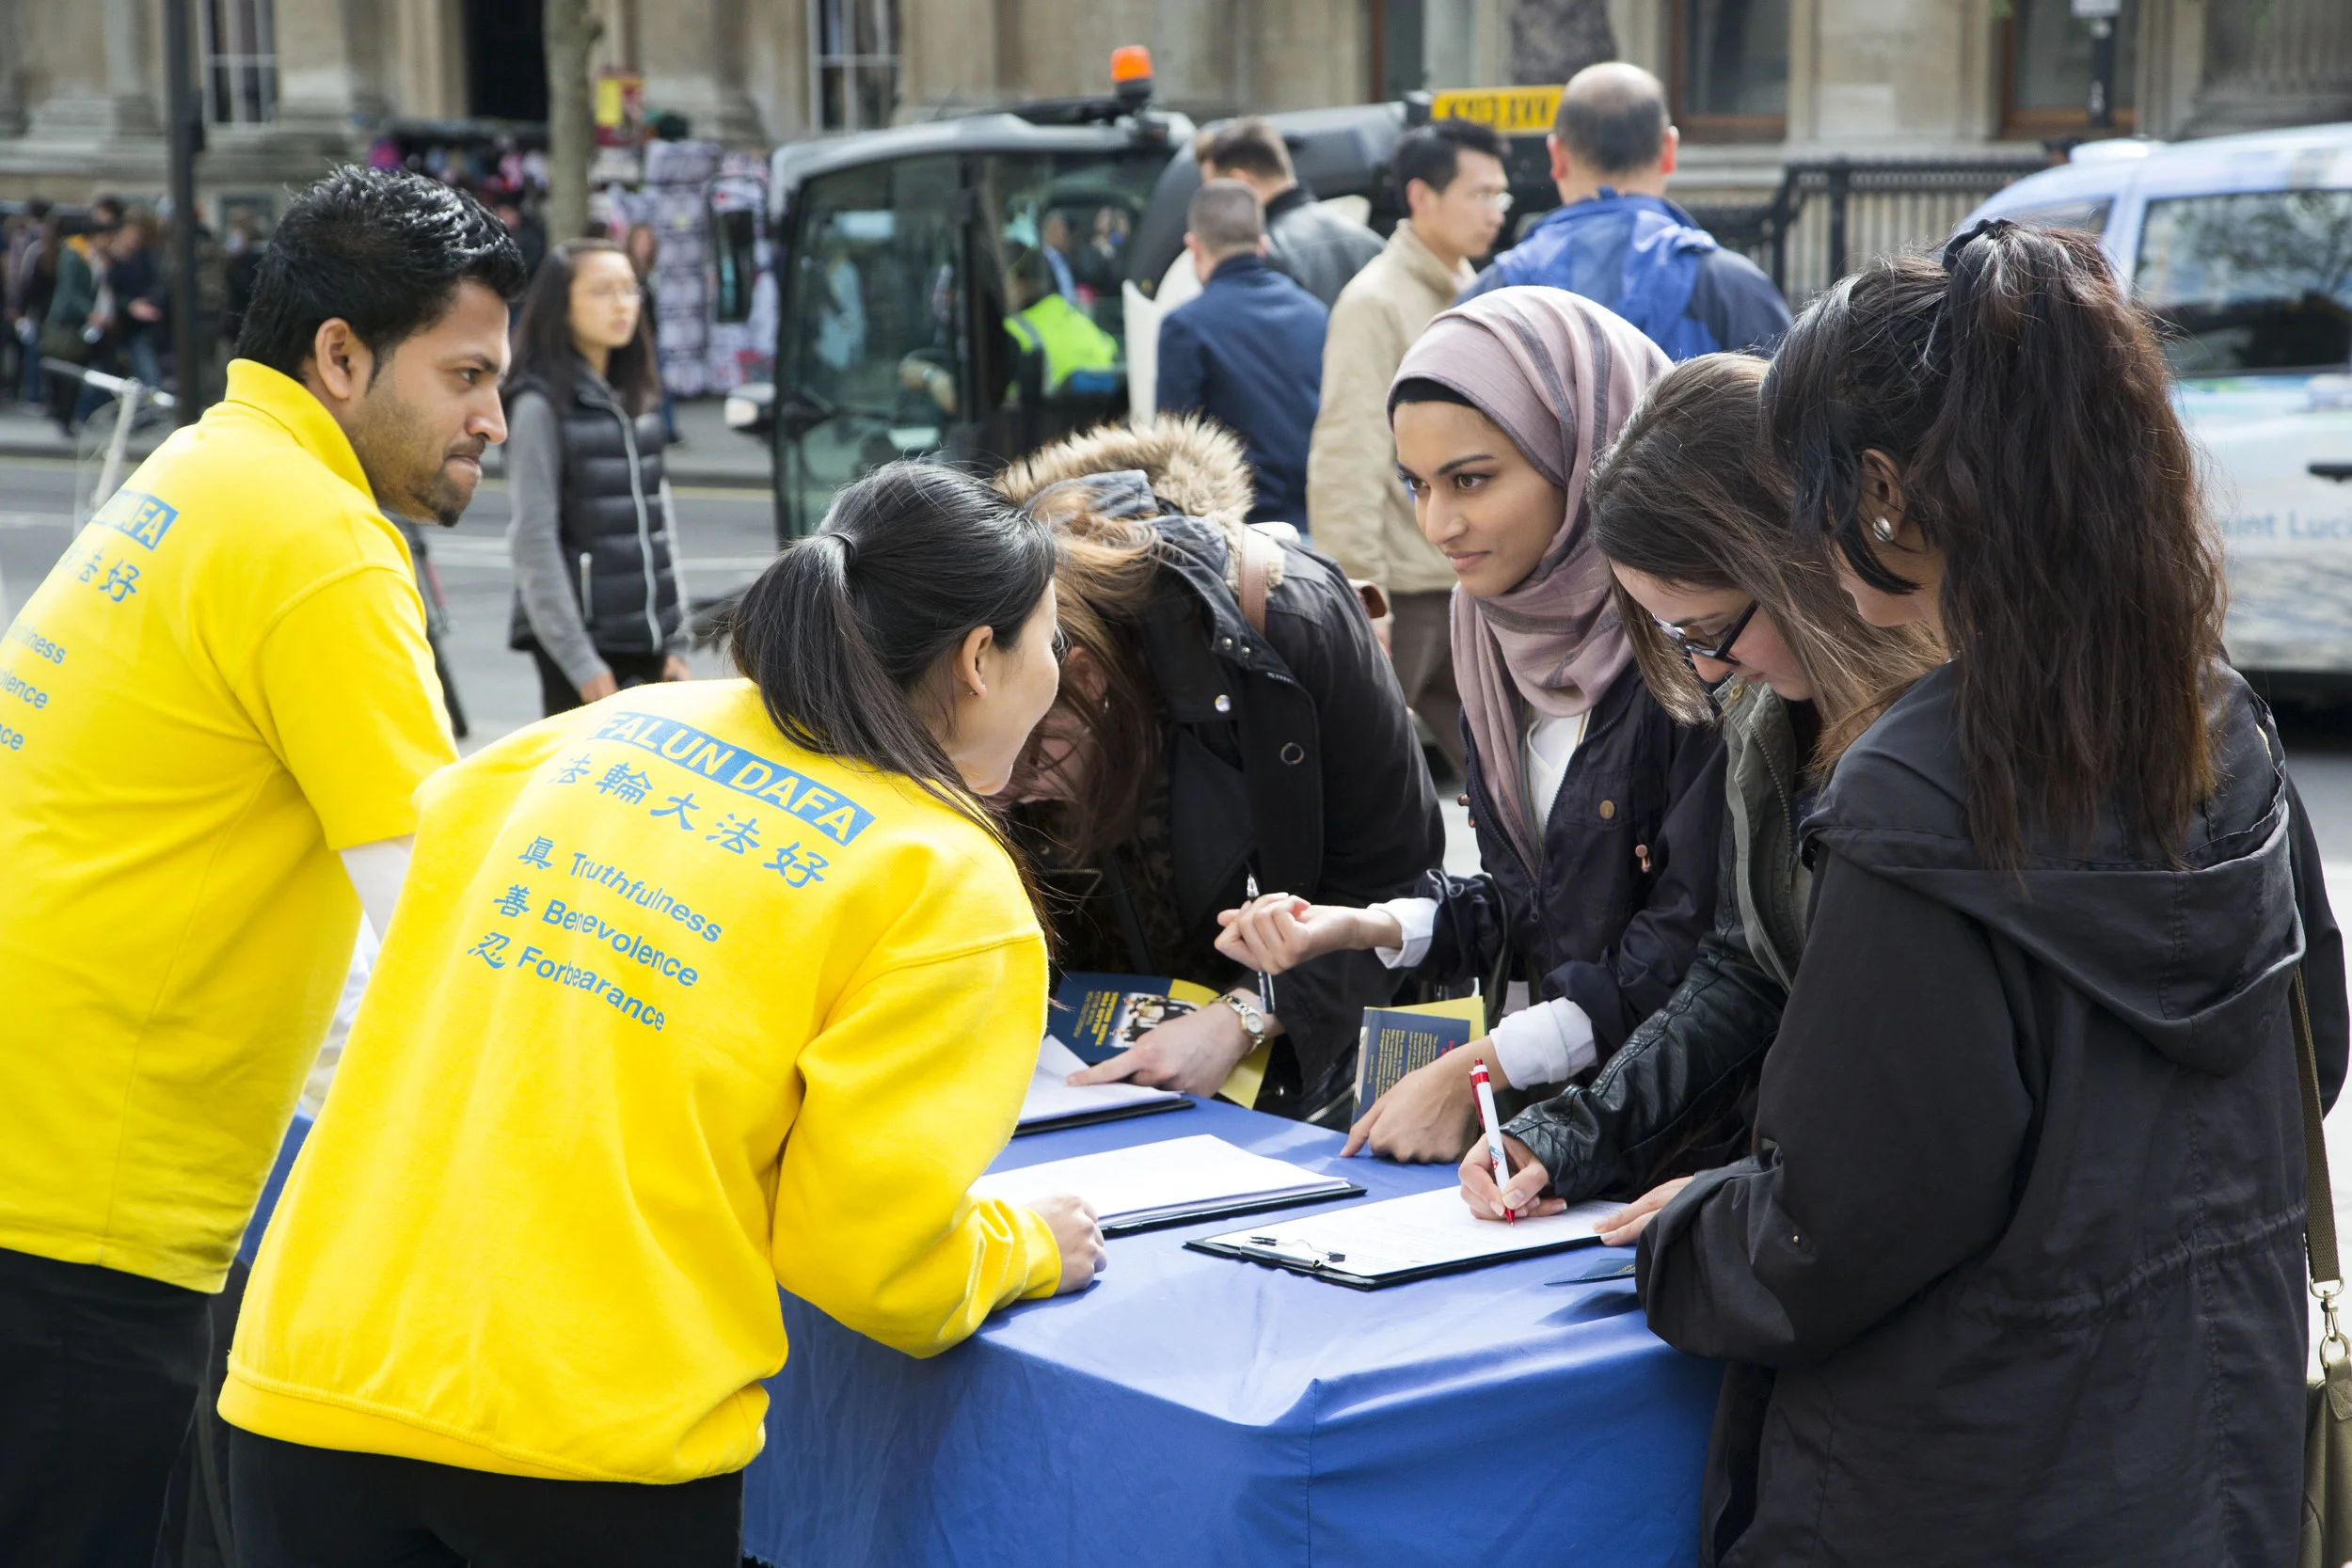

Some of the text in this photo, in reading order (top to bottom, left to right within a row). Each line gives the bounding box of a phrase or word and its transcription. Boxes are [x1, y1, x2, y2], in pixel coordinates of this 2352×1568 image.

[548, 752, 830, 889] 法輪大法好
[598, 714, 858, 843] FALUN DAFA
[493, 884, 531, 918] 善
[570, 851, 723, 942] Truthfulness
[467, 931, 511, 970] 忍
[542, 898, 699, 987] Benevolence
[516, 945, 666, 1032] Forbearance
